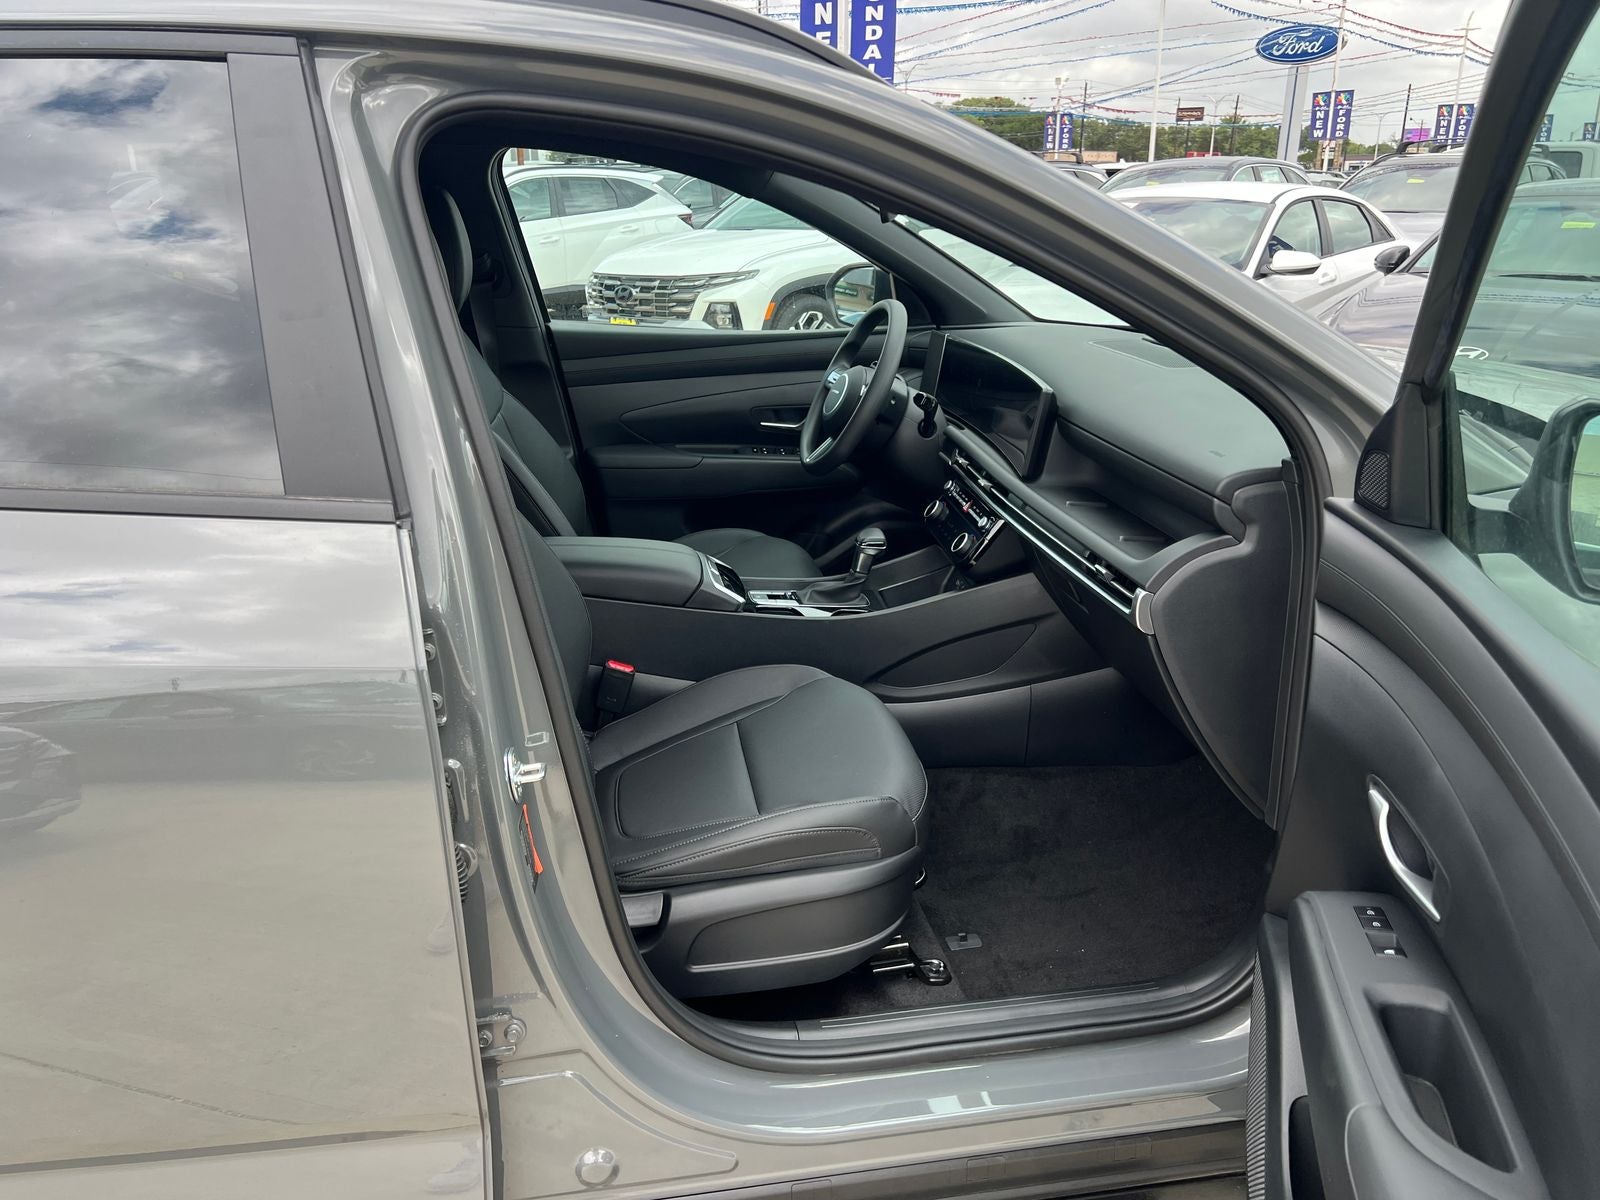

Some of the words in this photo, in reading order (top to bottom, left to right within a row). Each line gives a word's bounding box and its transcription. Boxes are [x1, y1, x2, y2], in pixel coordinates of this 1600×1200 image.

[1271, 30, 1326, 56] Ford
[1313, 110, 1325, 138] NEW
[1335, 109, 1347, 138] FORD
[1046, 128, 1054, 149] NEW
